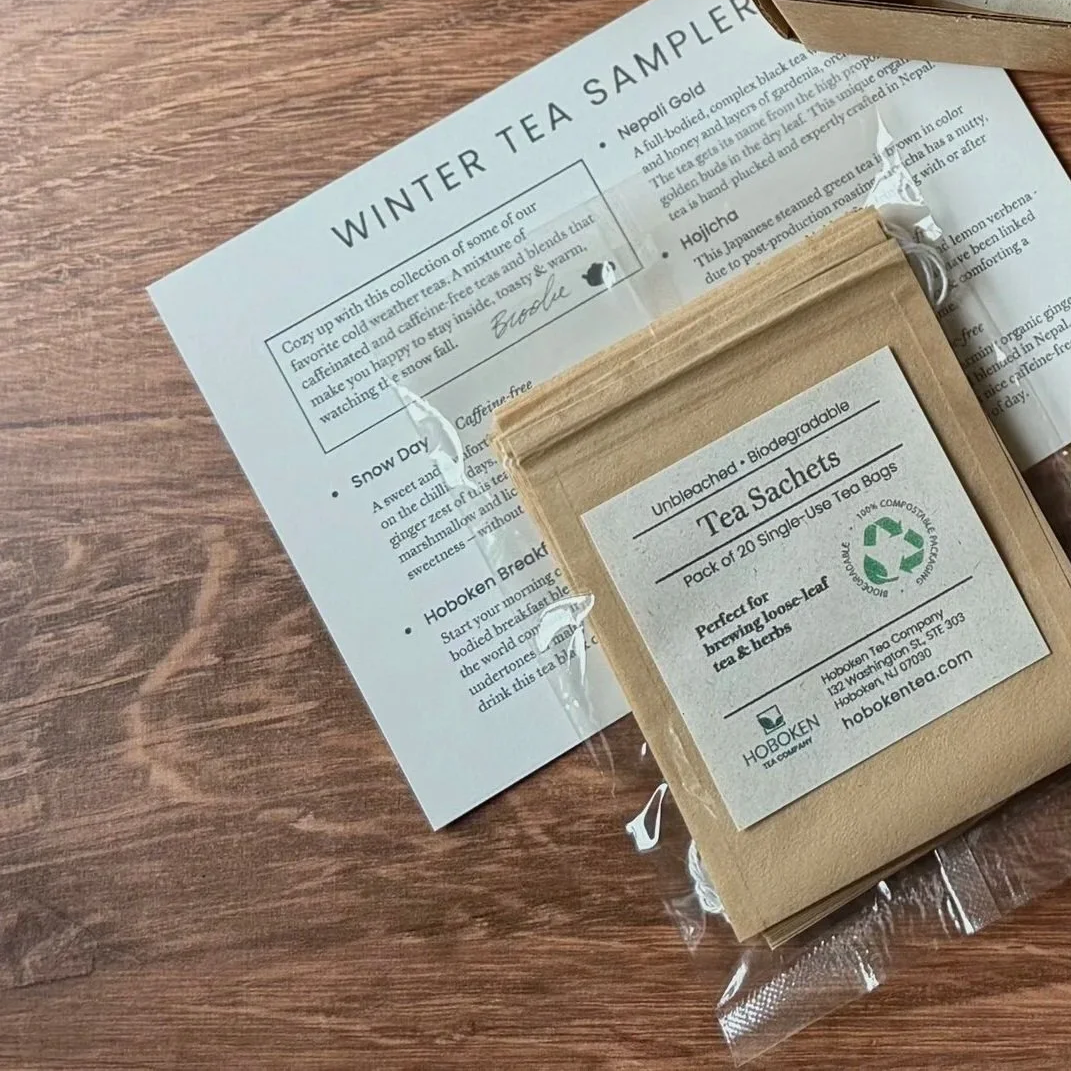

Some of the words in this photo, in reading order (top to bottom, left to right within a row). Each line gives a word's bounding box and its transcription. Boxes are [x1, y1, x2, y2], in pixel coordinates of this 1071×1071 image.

[616, 102, 669, 141] Nepali
[668, 80, 706, 110] Gold
[642, 108, 711, 152] full-bodied,
[709, 81, 758, 114] complex
[755, 61, 790, 86] black
[788, 52, 809, 68] tea
[922, 138, 946, 155] has
[954, 114, 989, 138] nutty,
[330, 149, 487, 249] WINTER
[494, 102, 573, 154] TEA
[679, 209, 740, 250] Hojicha
[281, 330, 315, 354] Cozy
[315, 320, 334, 336] up
[333, 302, 365, 324] with
[363, 288, 390, 308] this
[389, 253, 452, 294] collection
[451, 240, 466, 258] of
[466, 224, 500, 250] some
[500, 211, 515, 229] of
[515, 202, 537, 221] our
[290, 339, 341, 373] favorite
[341, 319, 369, 344] cold
[368, 292, 420, 327] weather
[419, 278, 452, 298] teas.
[461, 240, 513, 275] mixture
[513, 226, 527, 245] of
[999, 314, 1044, 346] organic
[455, 380, 533, 430] Caffeine-free
[746, 400, 850, 464] Biodegradable
[350, 456, 395, 489] Snow
[396, 436, 429, 462] Day
[650, 460, 739, 517] Unbleached
[695, 504, 750, 537] Tea
[747, 451, 841, 512] Sachets
[682, 561, 720, 588] Pack
[720, 549, 736, 568] of
[736, 539, 757, 559] 20
[756, 499, 833, 547] Single-Use
[831, 483, 862, 503] Tea
[860, 462, 898, 488] Bags
[856, 503, 878, 520] 100%
[880, 499, 935, 534] COMPOSTABLE
[915, 535, 939, 586] PACKAGING
[423, 577, 497, 625] Hoboken
[841, 541, 889, 598] BIODEGRADABLE
[694, 603, 748, 640] Perfect
[746, 591, 770, 611] for
[702, 616, 765, 657] brewing
[760, 575, 830, 624] loose-leaf
[820, 652, 870, 685] Hoboken
[867, 640, 892, 657] Tea
[890, 608, 944, 644] Company
[712, 655, 737, 673] tea
[749, 622, 793, 652] herbs
[827, 680, 846, 697] 132
[843, 645, 910, 686] Washington
[925, 623, 945, 641] STE
[944, 611, 966, 630] 303
[833, 677, 885, 710] Hoboken,
[883, 665, 899, 682] NJ
[898, 647, 933, 672] 07030
[841, 649, 974, 730] hobokentea.com
[742, 713, 821, 767] HOBOKEN
